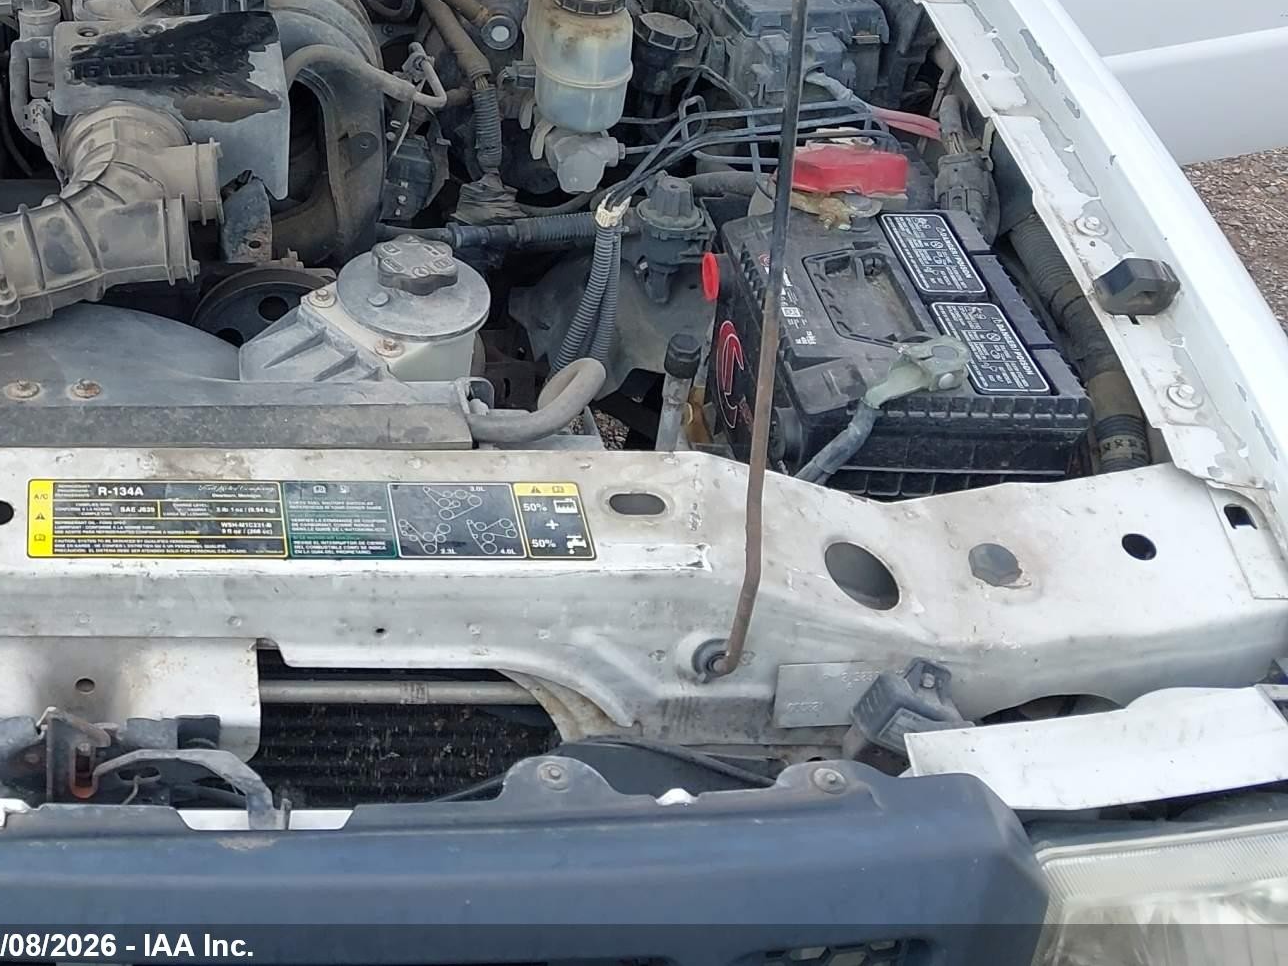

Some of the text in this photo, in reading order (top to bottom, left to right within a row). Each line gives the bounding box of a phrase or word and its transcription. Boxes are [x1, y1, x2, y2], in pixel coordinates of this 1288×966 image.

[98, 486, 144, 496] R-134A
[523, 503, 548, 512] 50%
[532, 539, 556, 548] 50%
